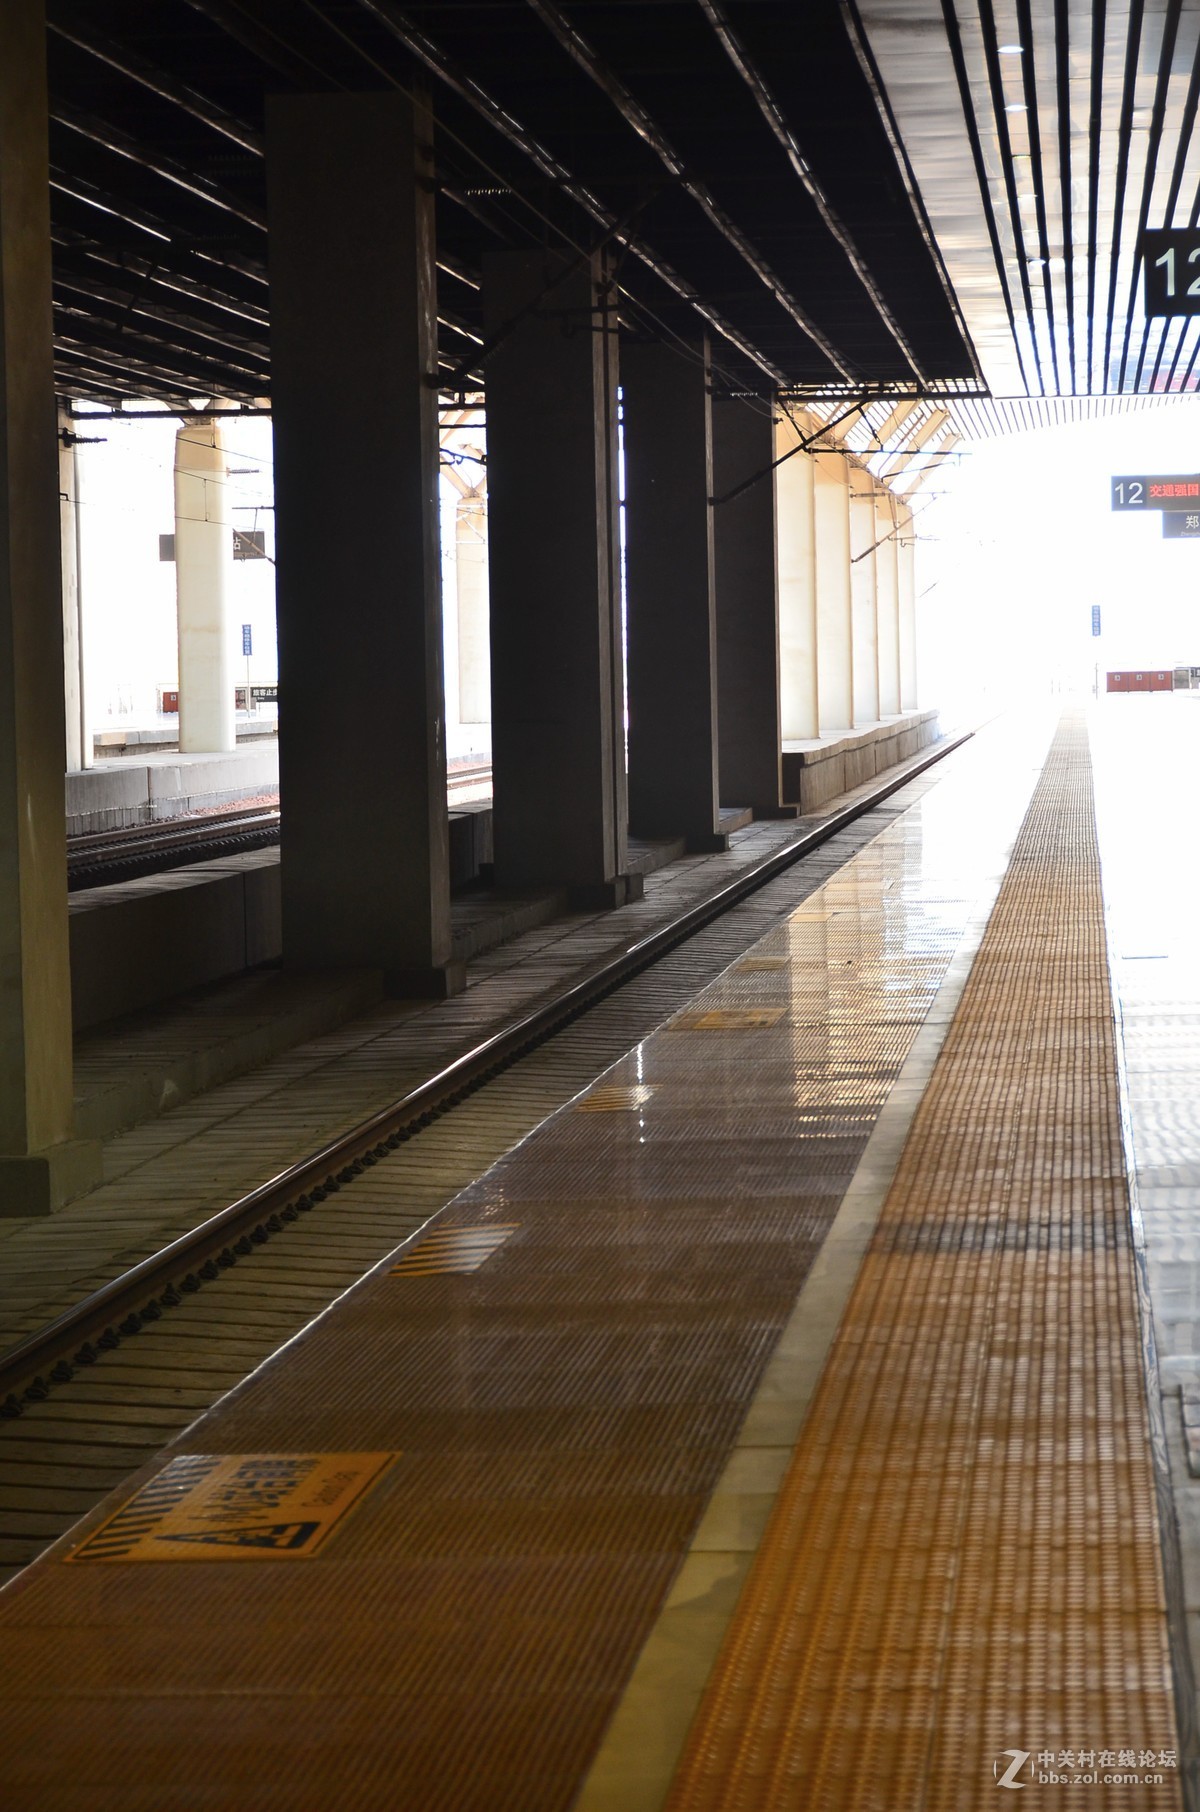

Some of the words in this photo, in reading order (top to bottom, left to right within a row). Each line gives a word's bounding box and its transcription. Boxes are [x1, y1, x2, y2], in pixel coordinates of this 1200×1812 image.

[1115, 482, 1143, 504] 12
[1150, 483, 1199, 497] 交通强国
[1185, 515, 1199, 529] 郑
